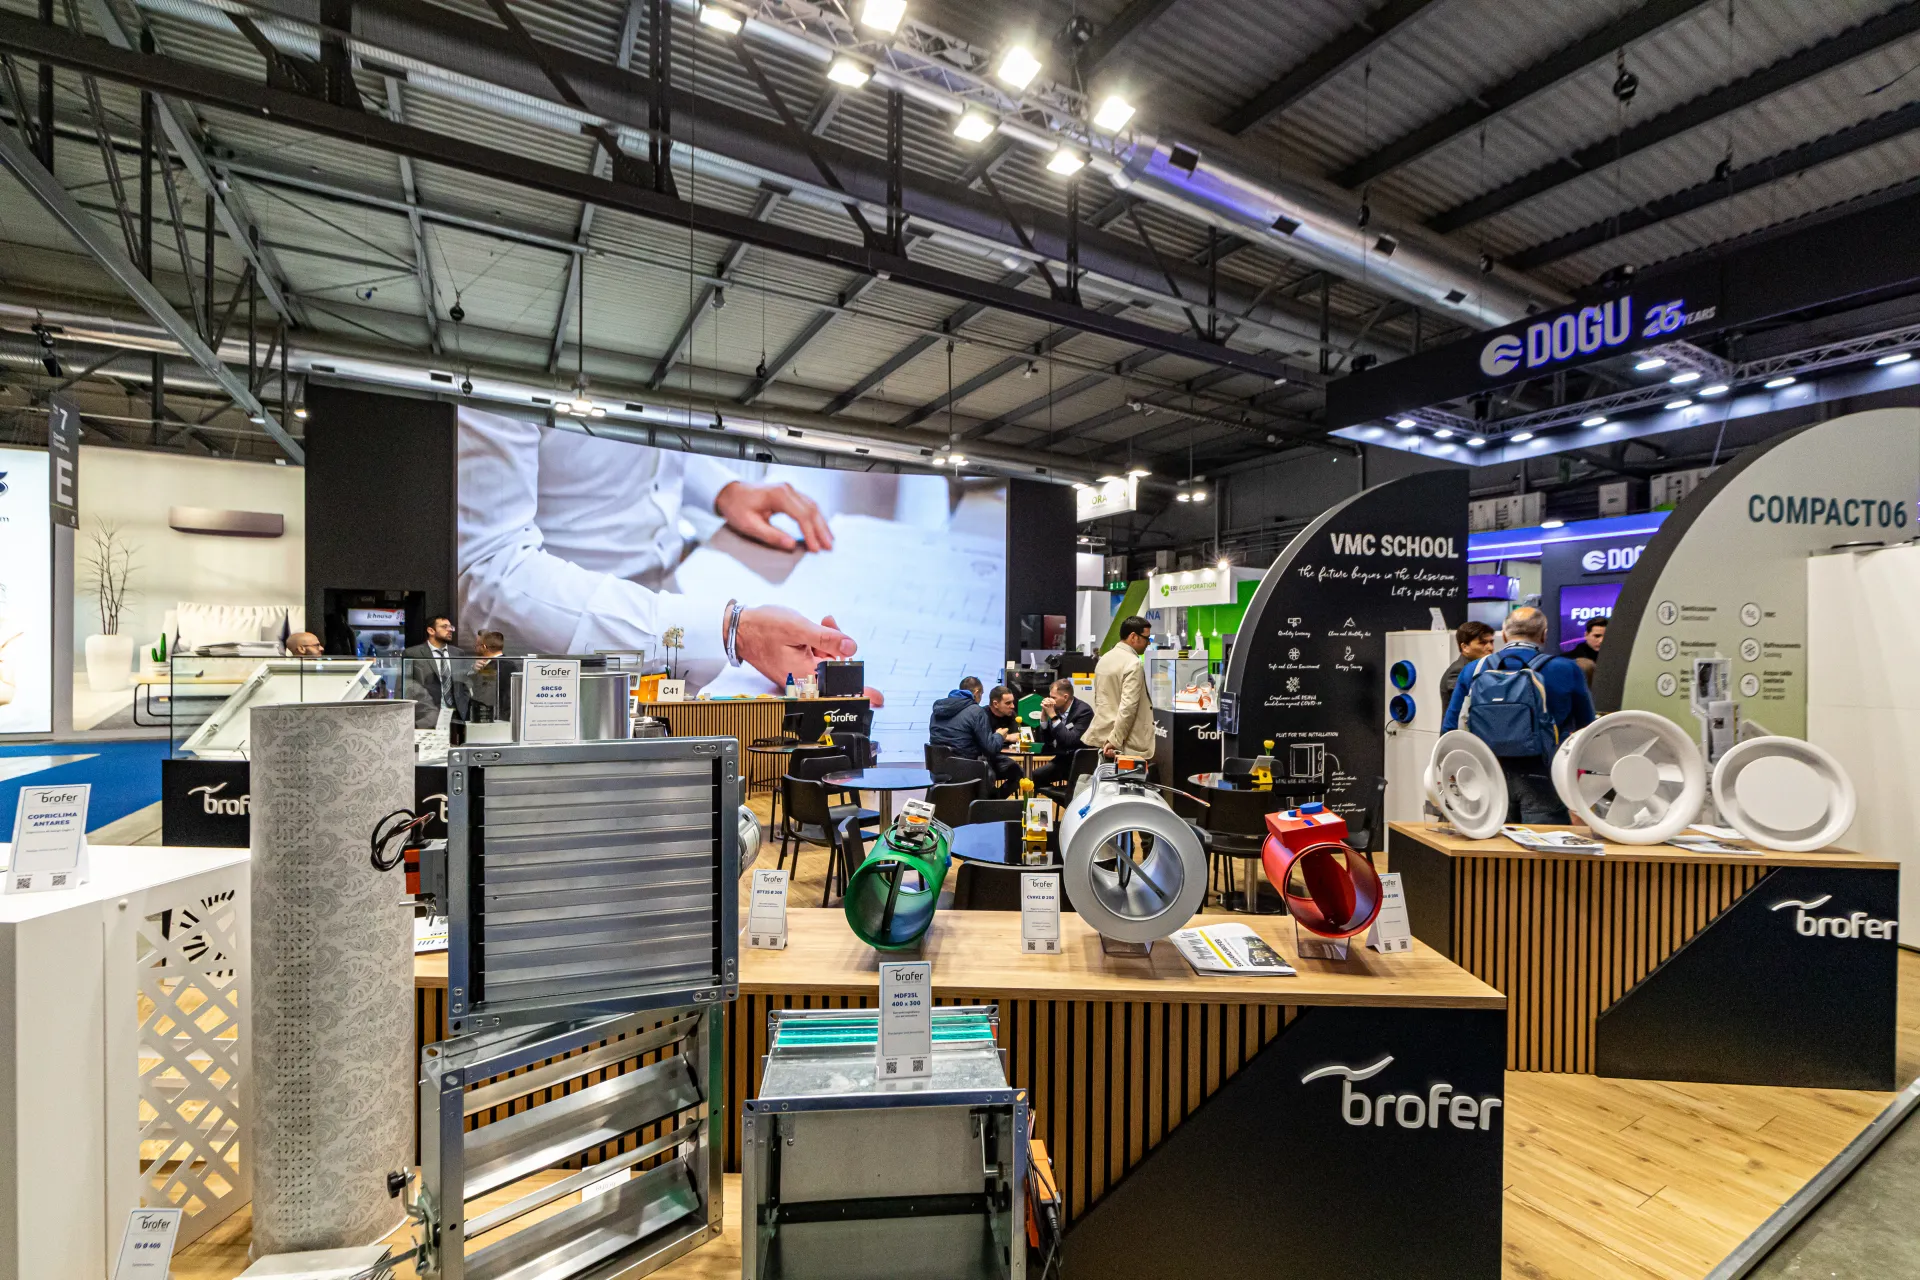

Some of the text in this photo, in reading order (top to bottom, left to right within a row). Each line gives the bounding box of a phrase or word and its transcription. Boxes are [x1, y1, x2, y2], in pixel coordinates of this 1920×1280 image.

[1526, 295, 1631, 368] DOGU
[1683, 306, 1717, 326] YEARS
[59, 407, 68, 431] 7
[56, 456, 73, 507] E
[1748, 493, 1908, 529] COMPACT06
[1329, 532, 1459, 559] VMC SCHOOL
[1318, 566, 1348, 583] future
[1351, 565, 1381, 585] begins
[1384, 572, 1393, 580] in
[1179, 582, 1217, 591] CORPORATION
[1391, 585, 1411, 597] Let's
[1413, 586, 1445, 601] protect
[1571, 606, 1614, 620] FOCU
[541, 667, 571, 676] brofer
[662, 686, 679, 695] C41
[830, 712, 858, 723] brofer
[41, 793, 78, 803] brofer
[27, 812, 78, 820] COPRICLIMA
[1032, 880, 1053, 888] brofer
[1796, 909, 1898, 940] brofer
[895, 971, 924, 981] brofer
[1341, 1079, 1502, 1131] brofer
[141, 1218, 171, 1229] brofer
